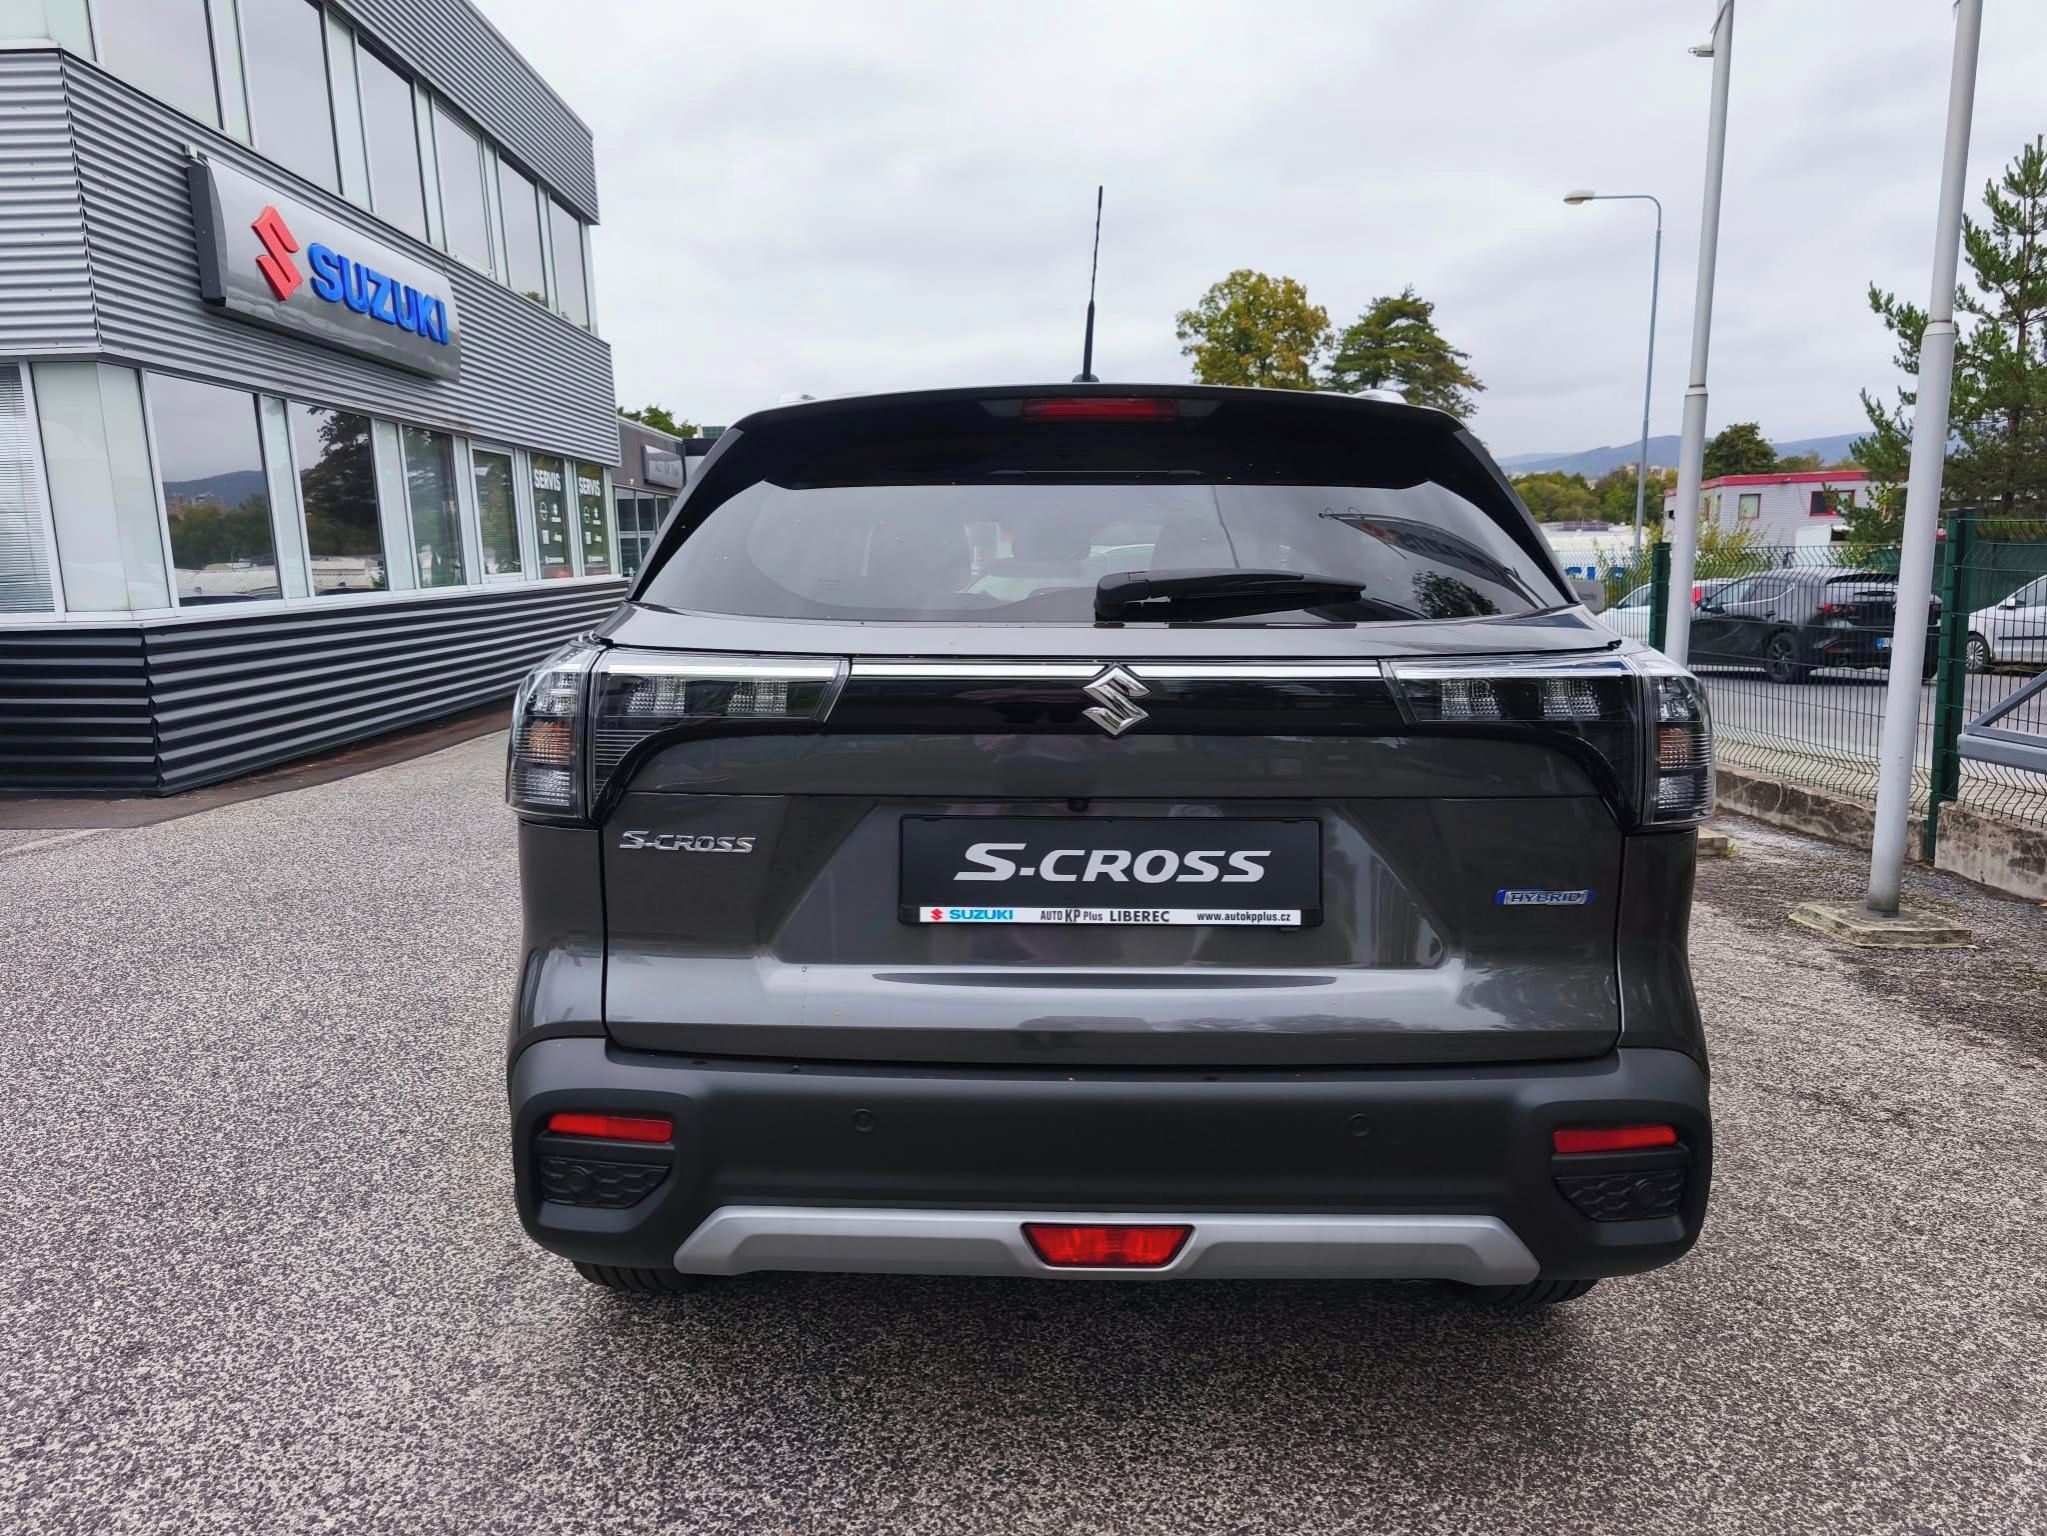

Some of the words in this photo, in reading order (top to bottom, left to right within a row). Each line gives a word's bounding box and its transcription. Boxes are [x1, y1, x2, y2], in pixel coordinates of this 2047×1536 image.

[307, 242, 449, 345] SUZUKI
[533, 468, 561, 492] SERVIS
[578, 476, 601, 497] SERVIS
[1510, 892, 1582, 903] HYBRID
[949, 909, 1014, 920] SUZUKI
[1040, 910, 1063, 921] AUTO
[1064, 909, 1081, 923] KP
[1083, 911, 1103, 921] Plus
[1109, 910, 1171, 922] LIBEREC
[1196, 911, 1291, 924] www.autokpplus.cz
